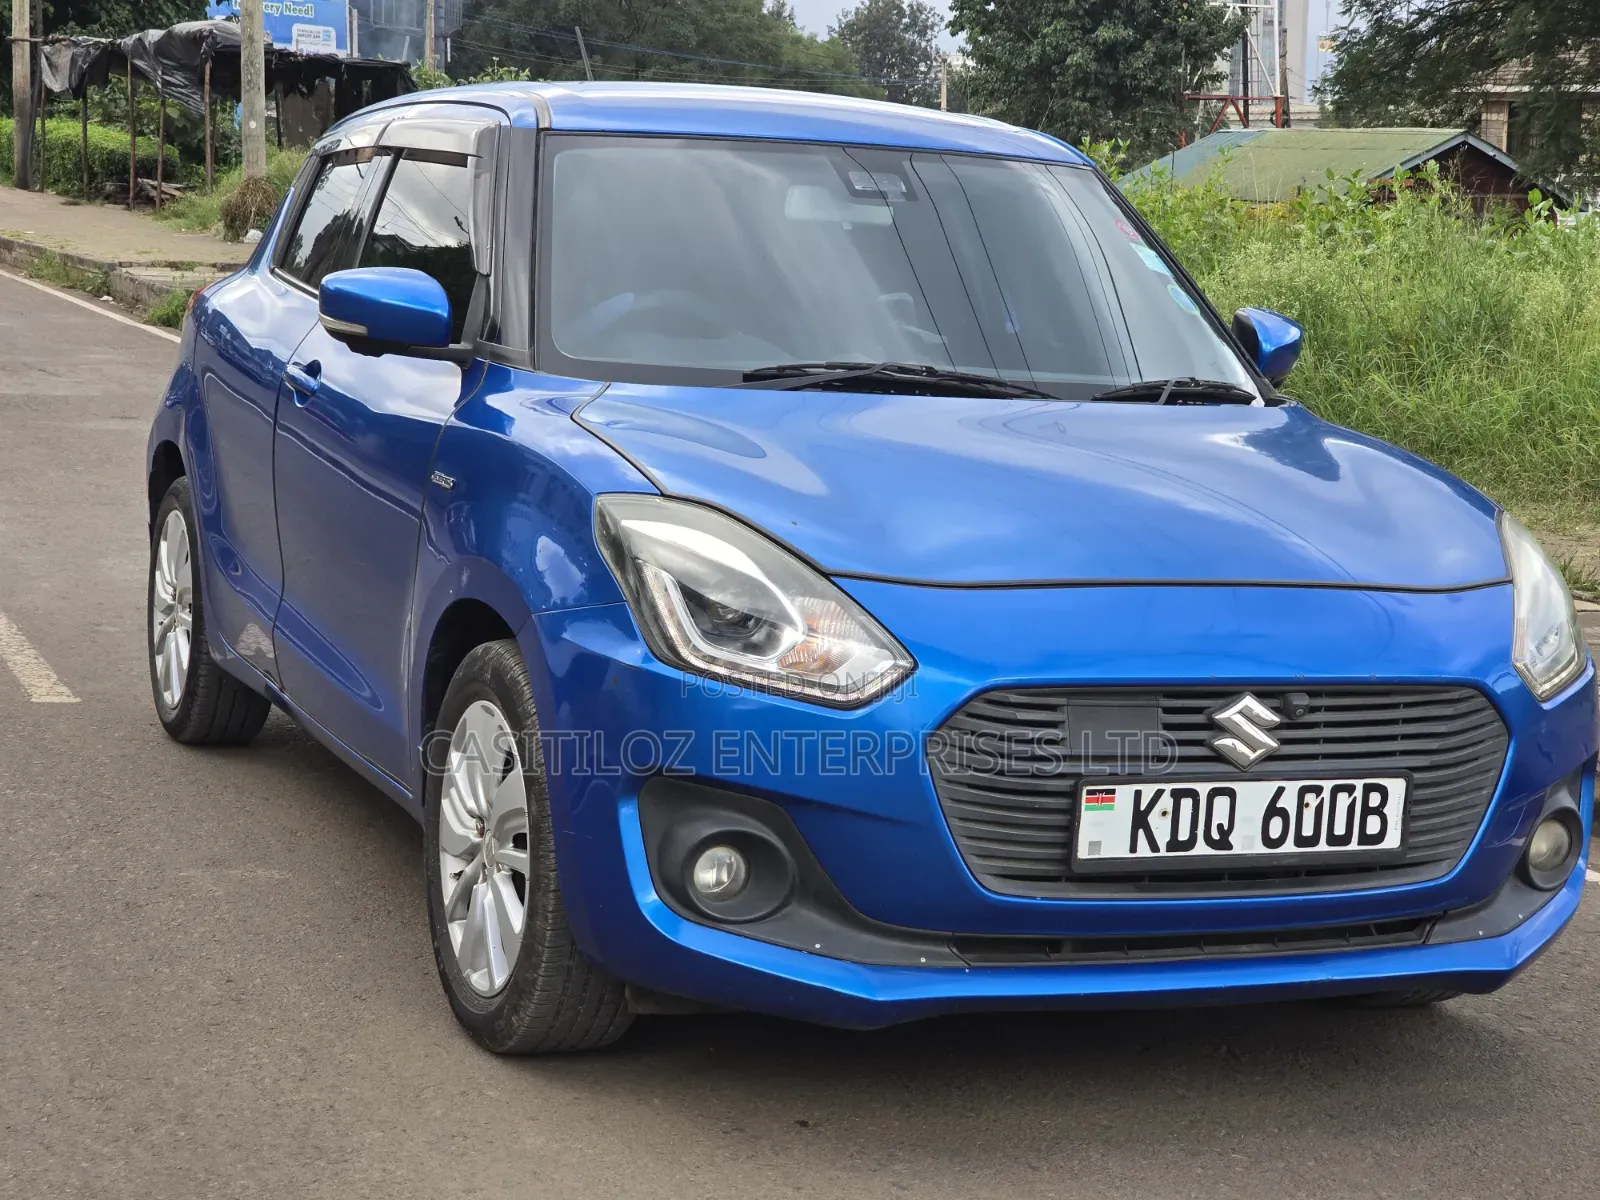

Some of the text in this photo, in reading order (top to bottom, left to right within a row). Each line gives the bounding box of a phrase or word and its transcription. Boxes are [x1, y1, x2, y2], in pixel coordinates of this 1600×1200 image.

[263, 2, 314, 17] ery Need!
[1129, 786, 1237, 854] KDQ
[1261, 782, 1389, 850] 600B
